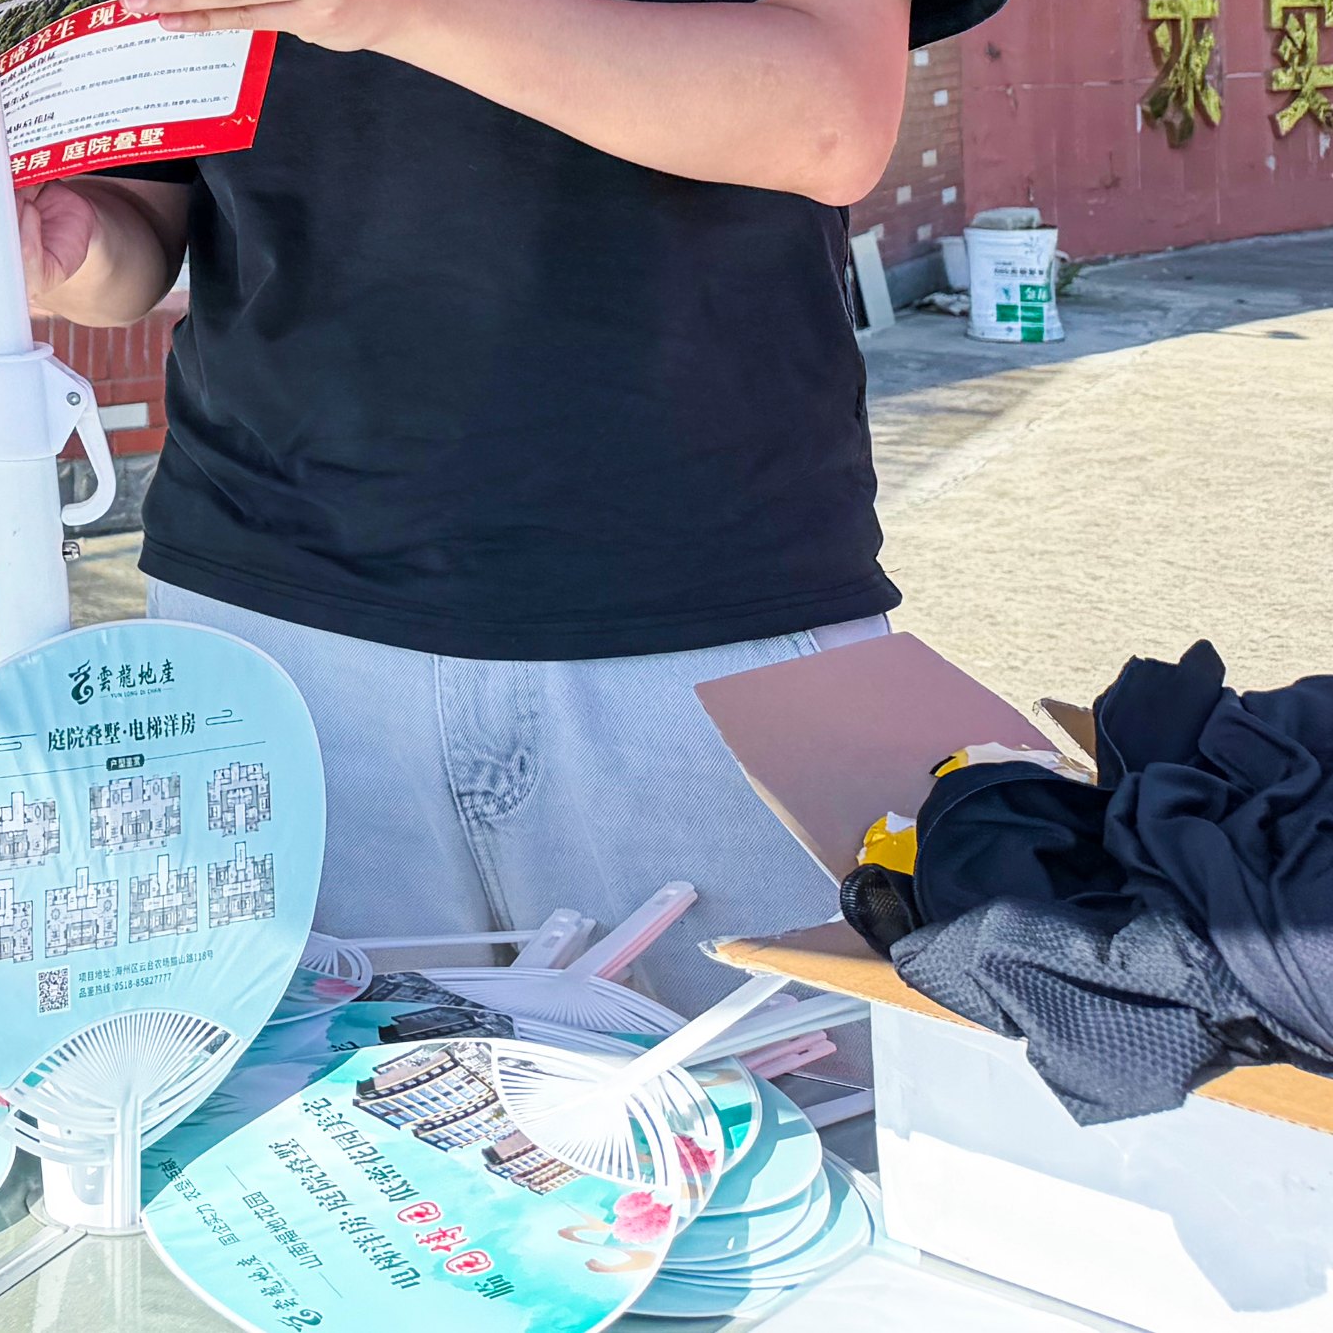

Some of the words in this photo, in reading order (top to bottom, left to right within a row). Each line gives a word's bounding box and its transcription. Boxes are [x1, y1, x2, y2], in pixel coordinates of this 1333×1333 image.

[62, 127, 165, 163] 庭院叠墅
[47, 711, 196, 753] 庭院叠墅·电梯洋房
[196, 1203, 240, 1246] 国企实力
[268, 1138, 421, 1289] 电梯洋房·庭院叠墅
